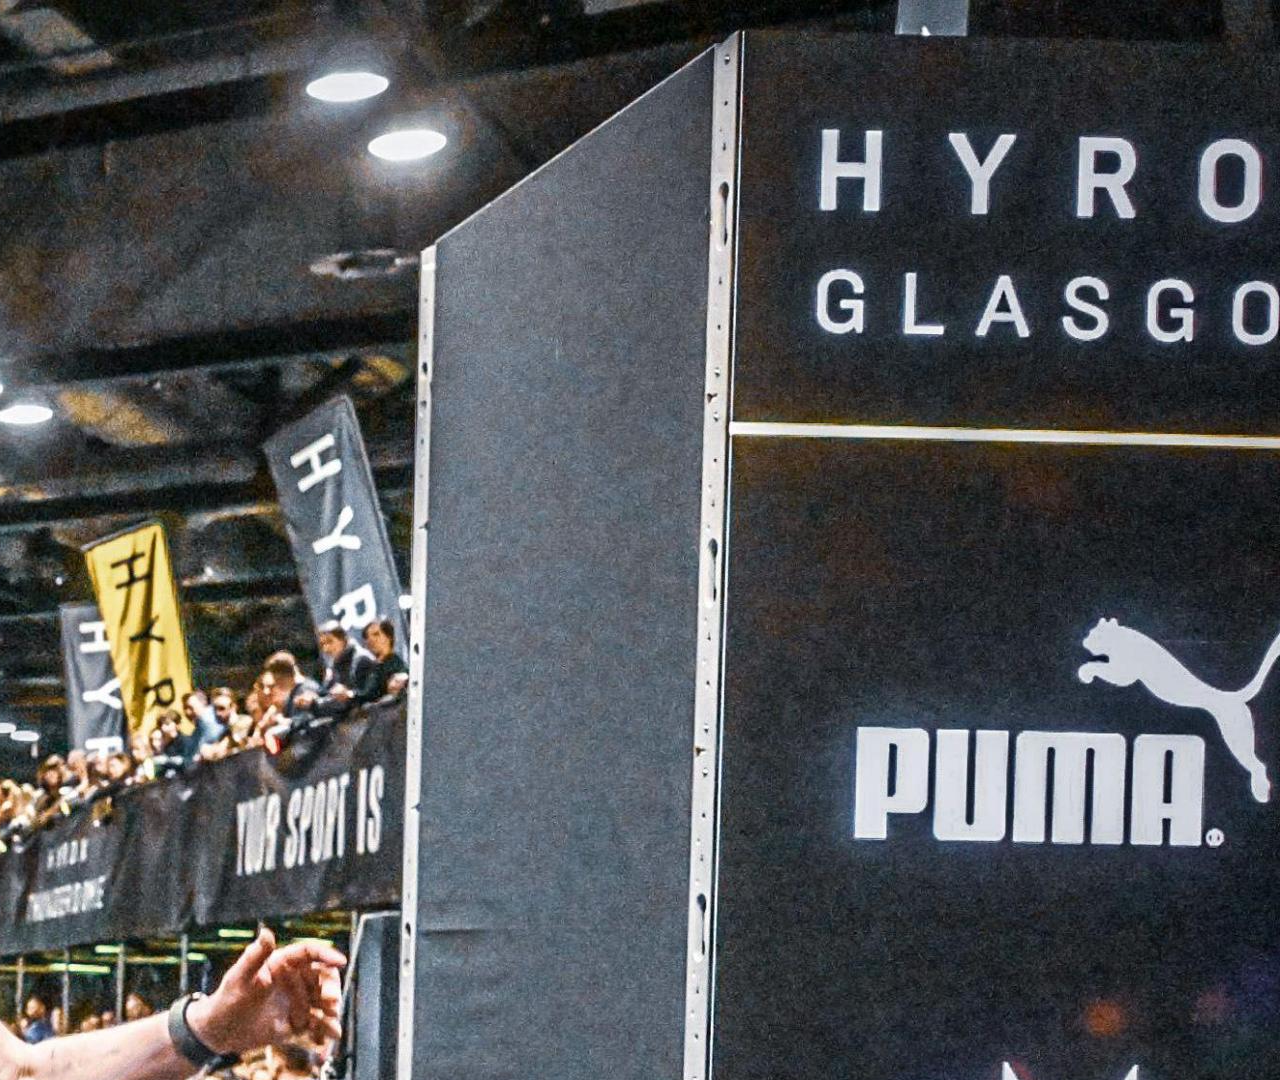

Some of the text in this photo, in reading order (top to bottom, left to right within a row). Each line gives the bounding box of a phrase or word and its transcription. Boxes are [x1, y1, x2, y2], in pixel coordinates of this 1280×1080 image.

[819, 128, 1264, 223] HYRO
[816, 268, 1280, 346] GLASGO
[356, 764, 385, 855] IS
